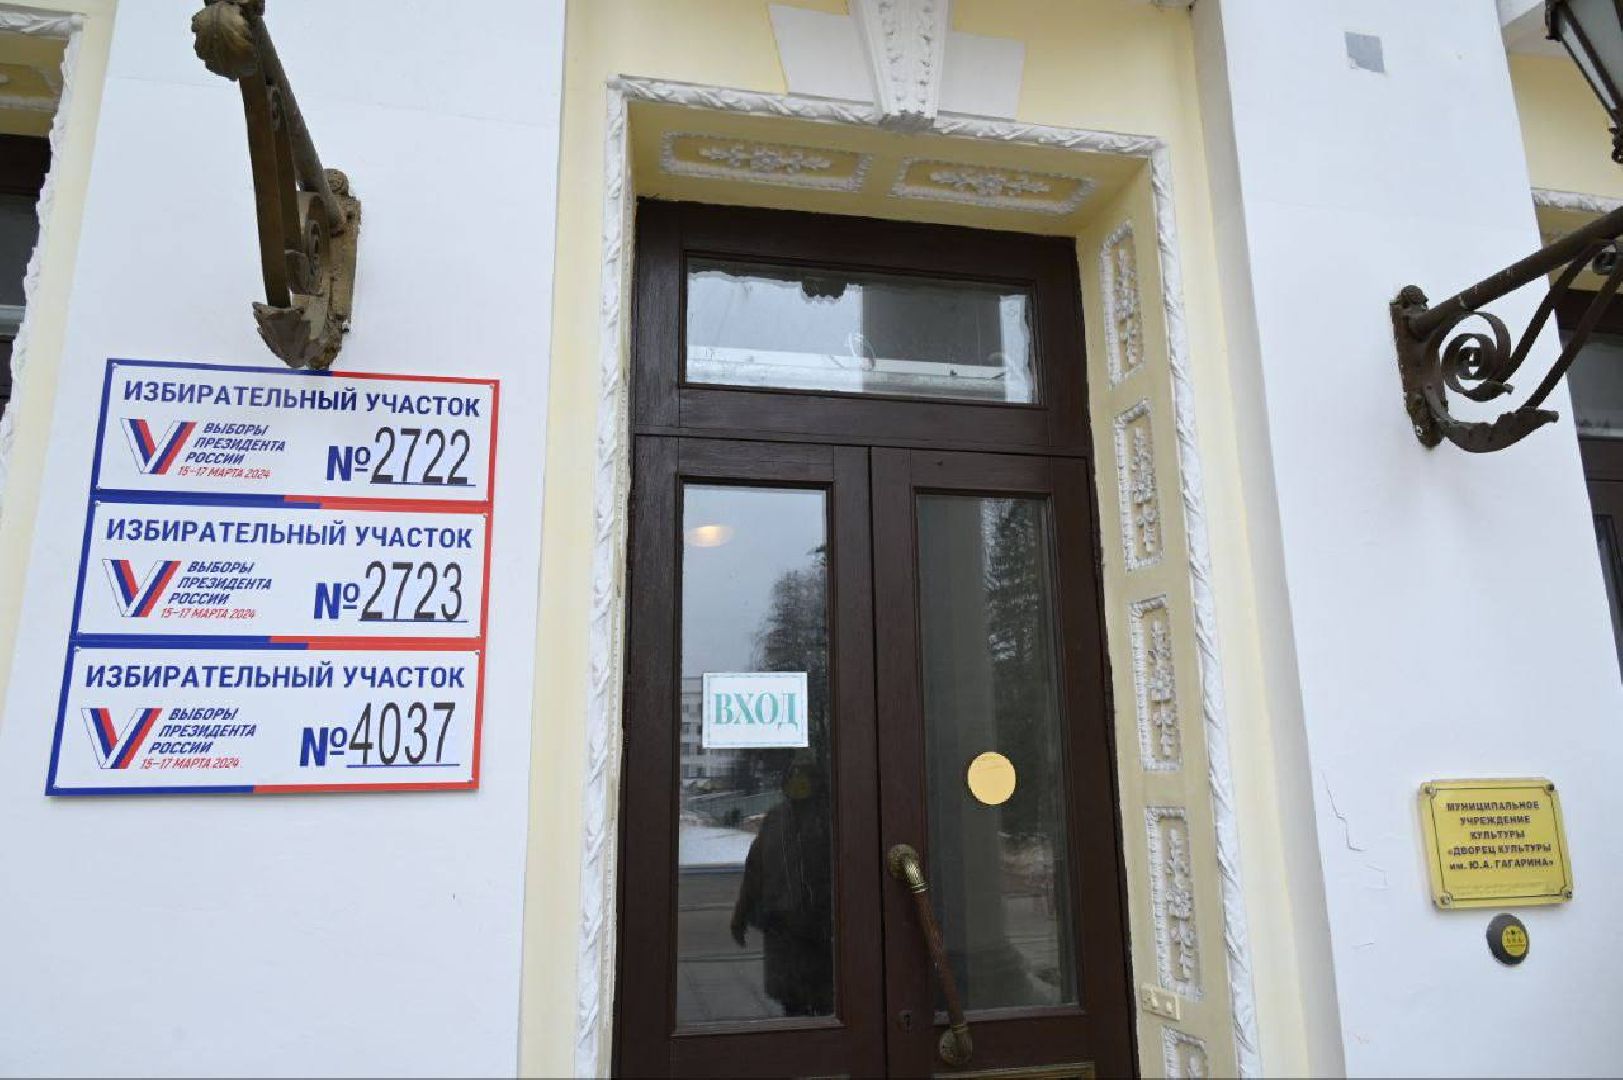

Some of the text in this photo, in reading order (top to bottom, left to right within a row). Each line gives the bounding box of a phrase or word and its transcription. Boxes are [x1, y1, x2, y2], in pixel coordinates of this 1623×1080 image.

[124, 380, 480, 417] ИЗБИРАТЕЛЬНЫЙ УЧАСТОК
[203, 422, 268, 436] ВЫБОРЫ
[193, 437, 286, 452] ПРЕЗИДЕНТА
[185, 452, 245, 464] РОССИИ
[207, 467, 243, 478] МАРТА
[244, 469, 271, 479] 2024
[106, 519, 472, 549] ИЗБИРАТЕЛЬНЫЙ УЧАСТОК
[187, 561, 254, 573] ВЫБОРЫ
[177, 577, 272, 590] ПРЕЗИДЕНТА
[168, 592, 230, 605] РОССИИ
[191, 609, 228, 618] МАРТА
[229, 609, 256, 619] 2024
[85, 661, 465, 689] ИЗБИРАТЕЛЬНЫЙ УЧАСТОК
[168, 708, 239, 720] ВЫБОРЫ
[713, 692, 799, 731] ВХОД
[158, 725, 257, 738] ПРЕЗИДЕНТА
[148, 742, 213, 754] РОССИИ
[173, 758, 211, 769] МАРТА
[212, 758, 240, 769] 2024
[1446, 800, 1540, 812] МУНИЦИПАЛЬНОЕ
[1459, 815, 1531, 826] УЧРЕЖДЕНИЕ
[1469, 830, 1525, 840] КУЛЬТУРЫ
[1498, 843, 1551, 854] КУЛЬТУРЫ
[1449, 863, 1467, 871] им.
